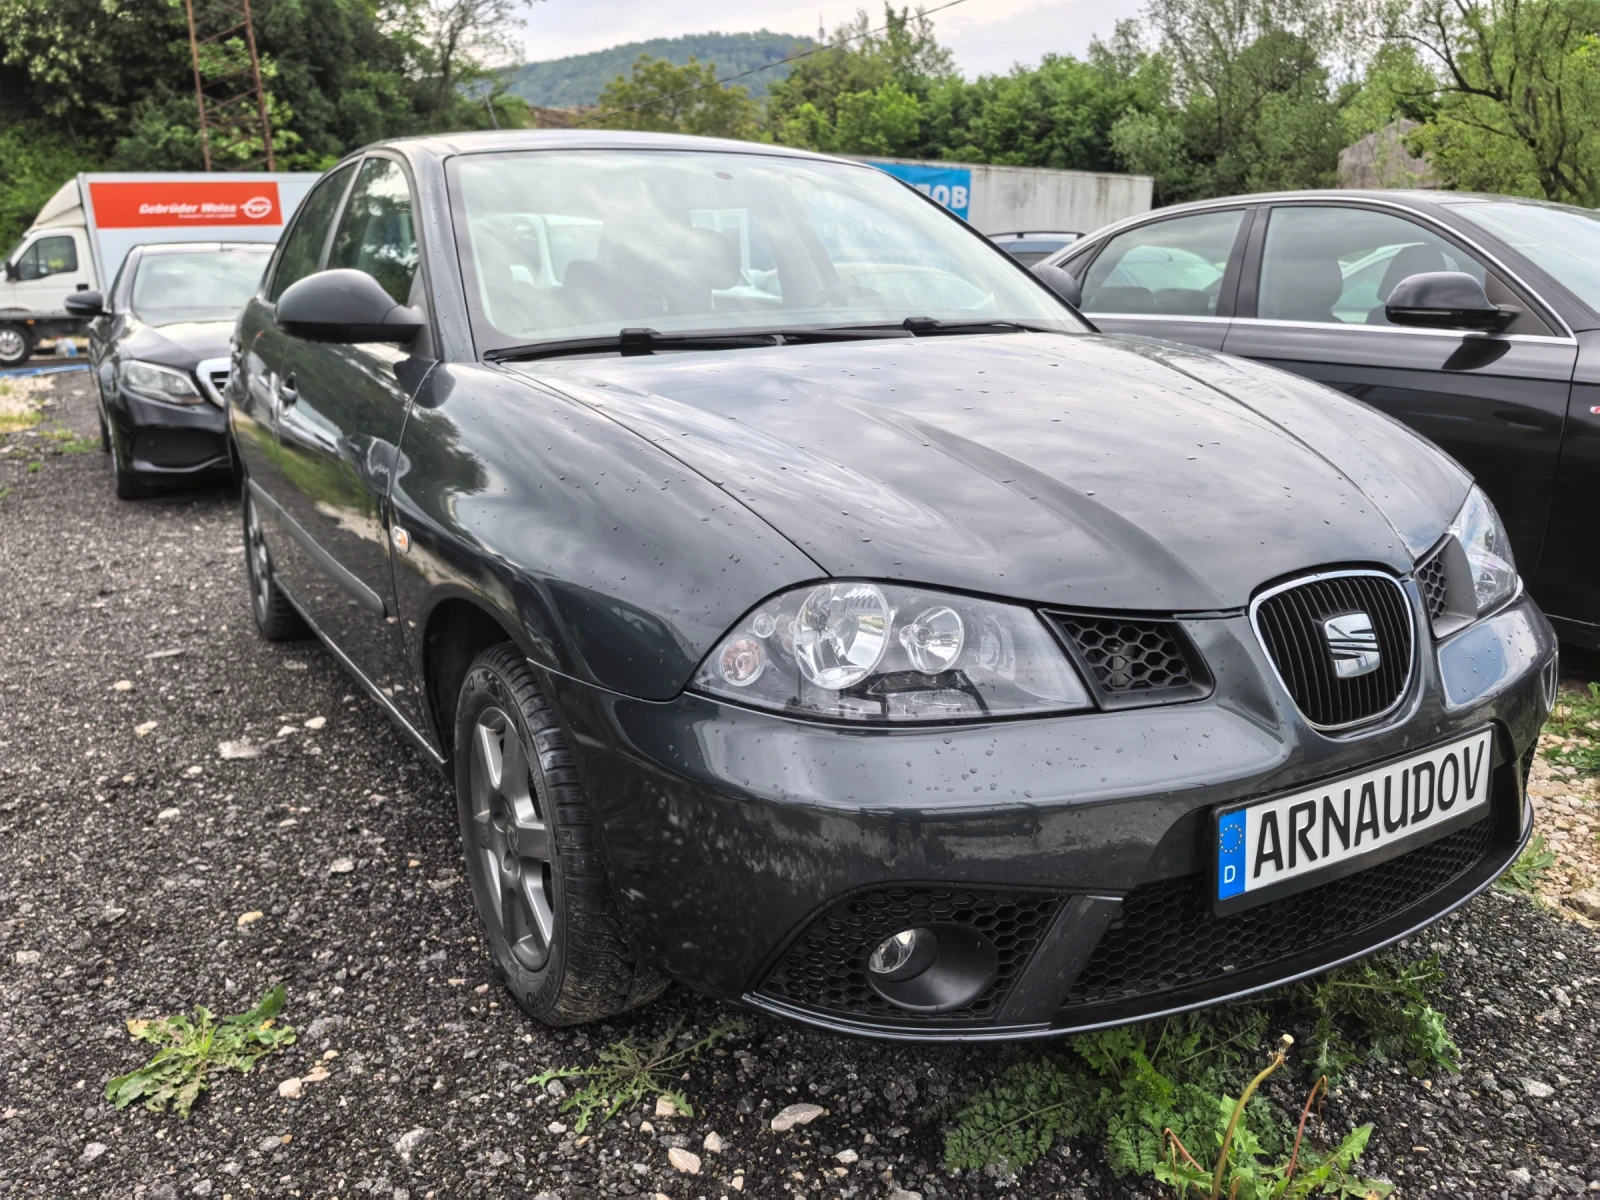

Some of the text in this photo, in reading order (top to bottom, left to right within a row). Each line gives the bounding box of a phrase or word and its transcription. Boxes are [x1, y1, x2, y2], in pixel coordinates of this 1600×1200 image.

[138, 202, 237, 214] Gebrüder Weiss
[1253, 739, 1485, 879] ARNAUDOV
[1223, 864, 1236, 884] D
